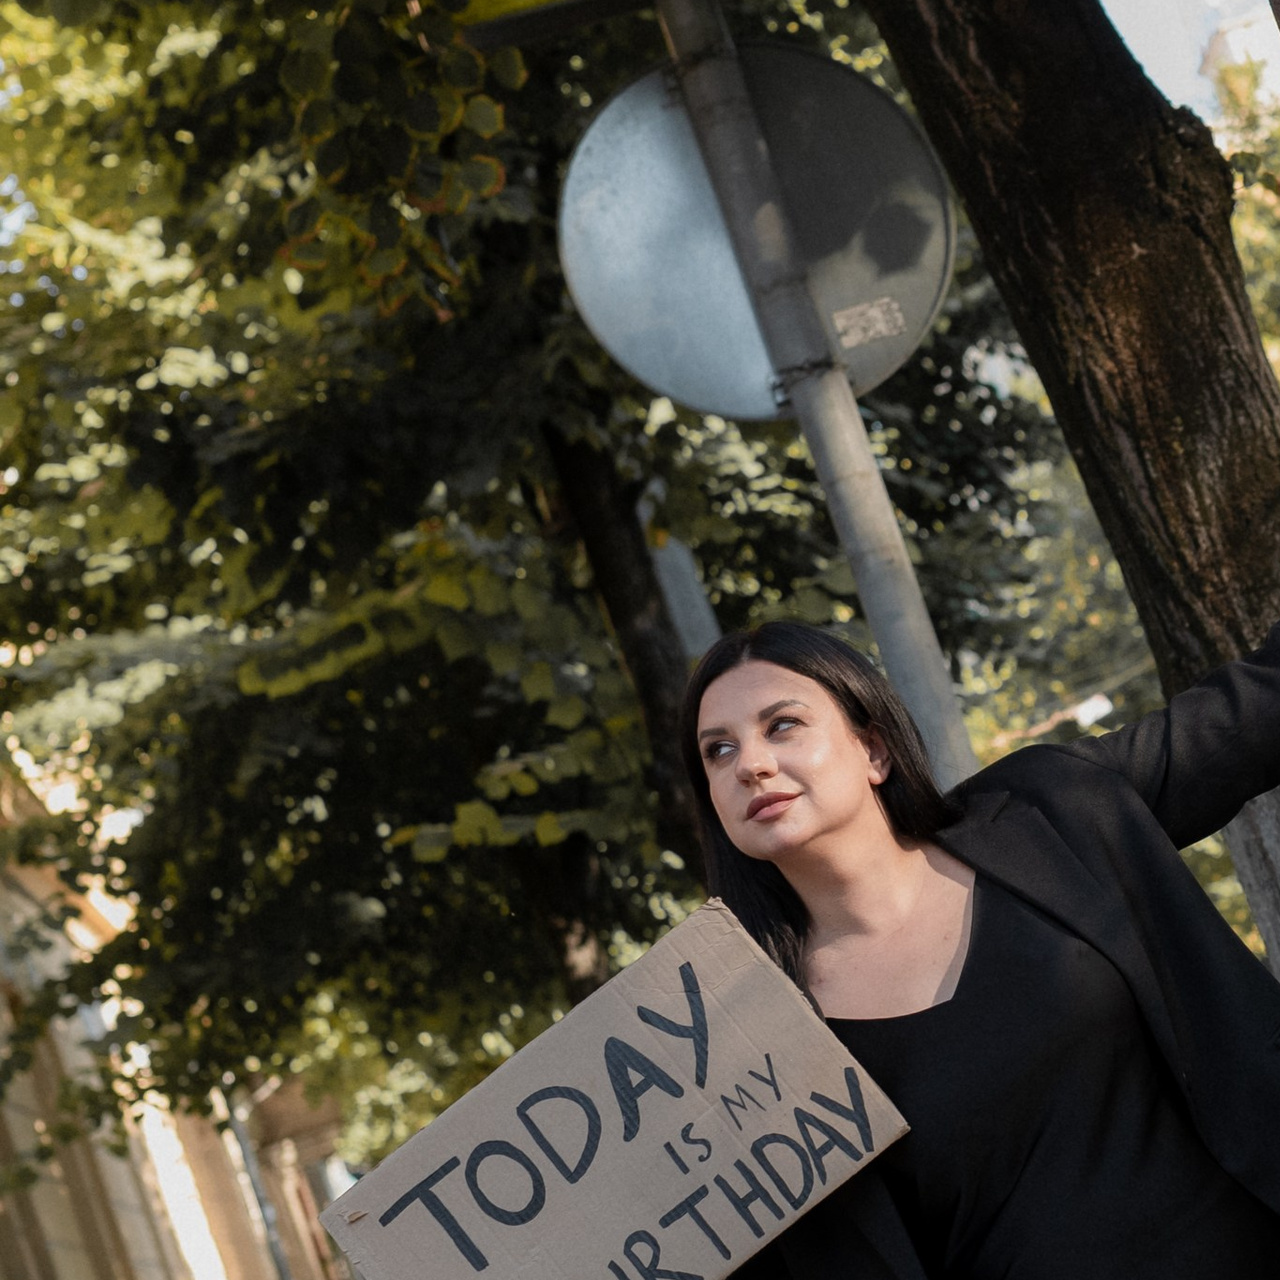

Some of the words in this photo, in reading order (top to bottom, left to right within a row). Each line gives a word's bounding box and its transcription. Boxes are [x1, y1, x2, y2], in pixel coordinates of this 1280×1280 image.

[379, 961, 710, 1272] TODAY
[663, 1122, 712, 1174] IS
[720, 1053, 782, 1130] MY
